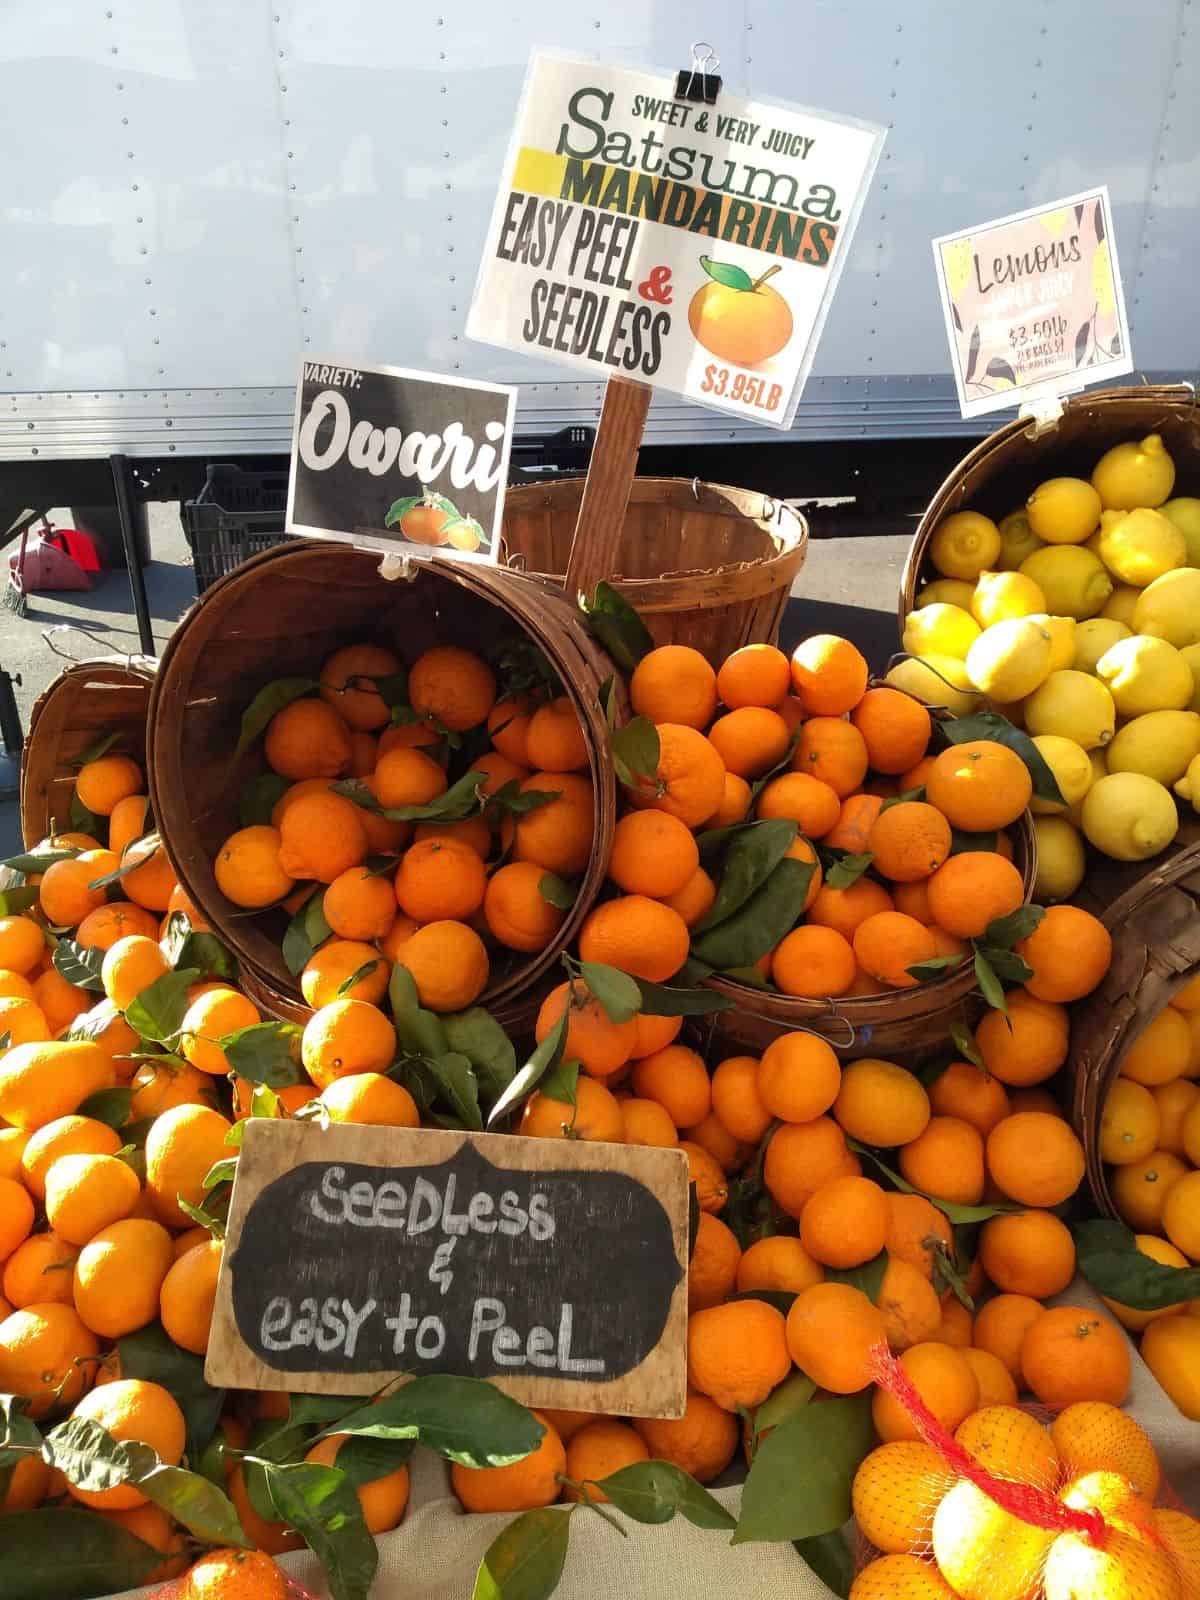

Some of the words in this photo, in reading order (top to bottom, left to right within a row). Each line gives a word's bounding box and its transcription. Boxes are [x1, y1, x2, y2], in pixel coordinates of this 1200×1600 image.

[556, 87, 842, 222] Satsuma
[631, 94, 693, 130] SWEET
[693, 112, 709, 133] &
[715, 115, 761, 147] VERY
[761, 128, 816, 160] JUICY
[496, 192, 574, 271] EASY
[568, 207, 641, 291] PEEL
[638, 266, 673, 305] &
[560, 158, 840, 267] MANDARINS
[973, 234, 1082, 294] Lemons
[522, 279, 671, 376] SEEDLESS
[304, 363, 364, 390] VARIETY:
[700, 364, 783, 413] $3.95LB
[300, 389, 504, 493] Owari
[385, 1293, 446, 1360] to
